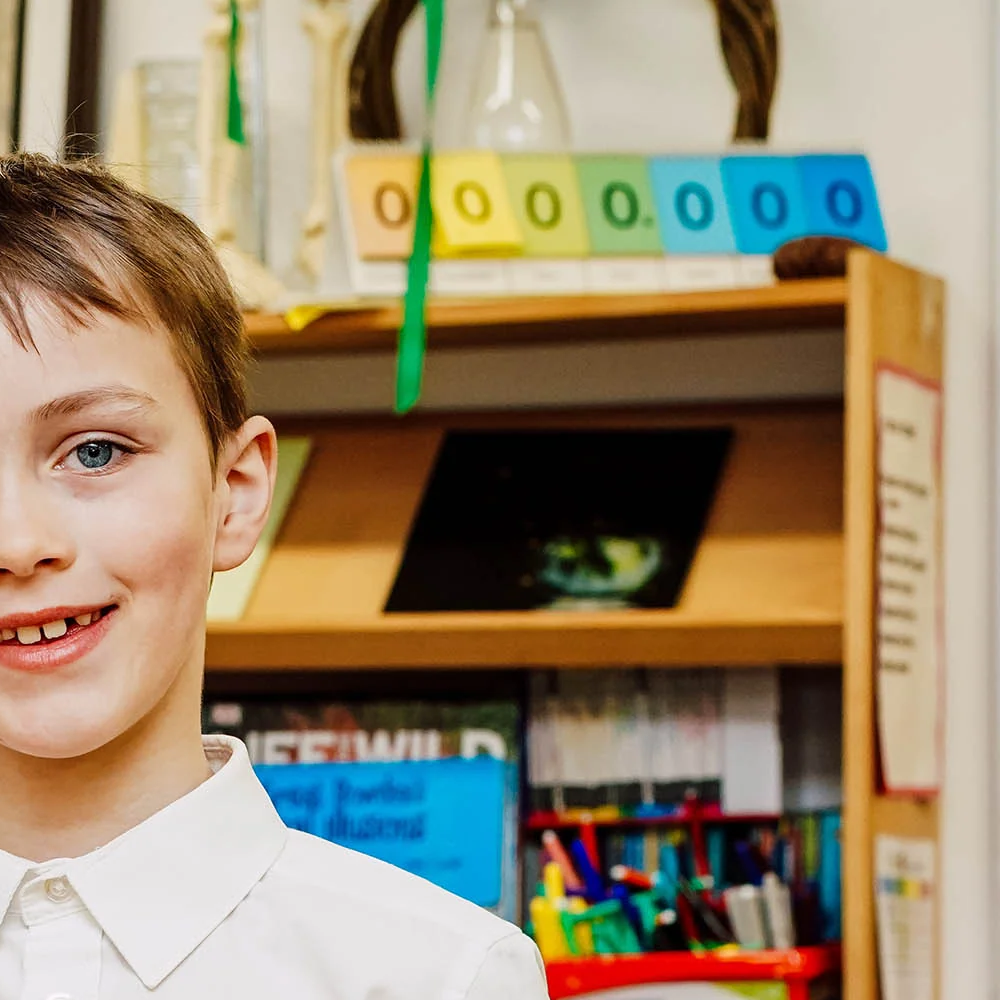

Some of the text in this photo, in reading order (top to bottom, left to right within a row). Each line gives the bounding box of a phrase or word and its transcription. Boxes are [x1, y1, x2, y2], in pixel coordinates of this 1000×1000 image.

[374, 180, 412, 231] 0
[453, 179, 493, 226] 0
[525, 180, 562, 231] 0
[675, 180, 715, 231] 0
[751, 181, 789, 231] 0
[825, 179, 863, 229] 0
[247, 729, 338, 765] IFE
